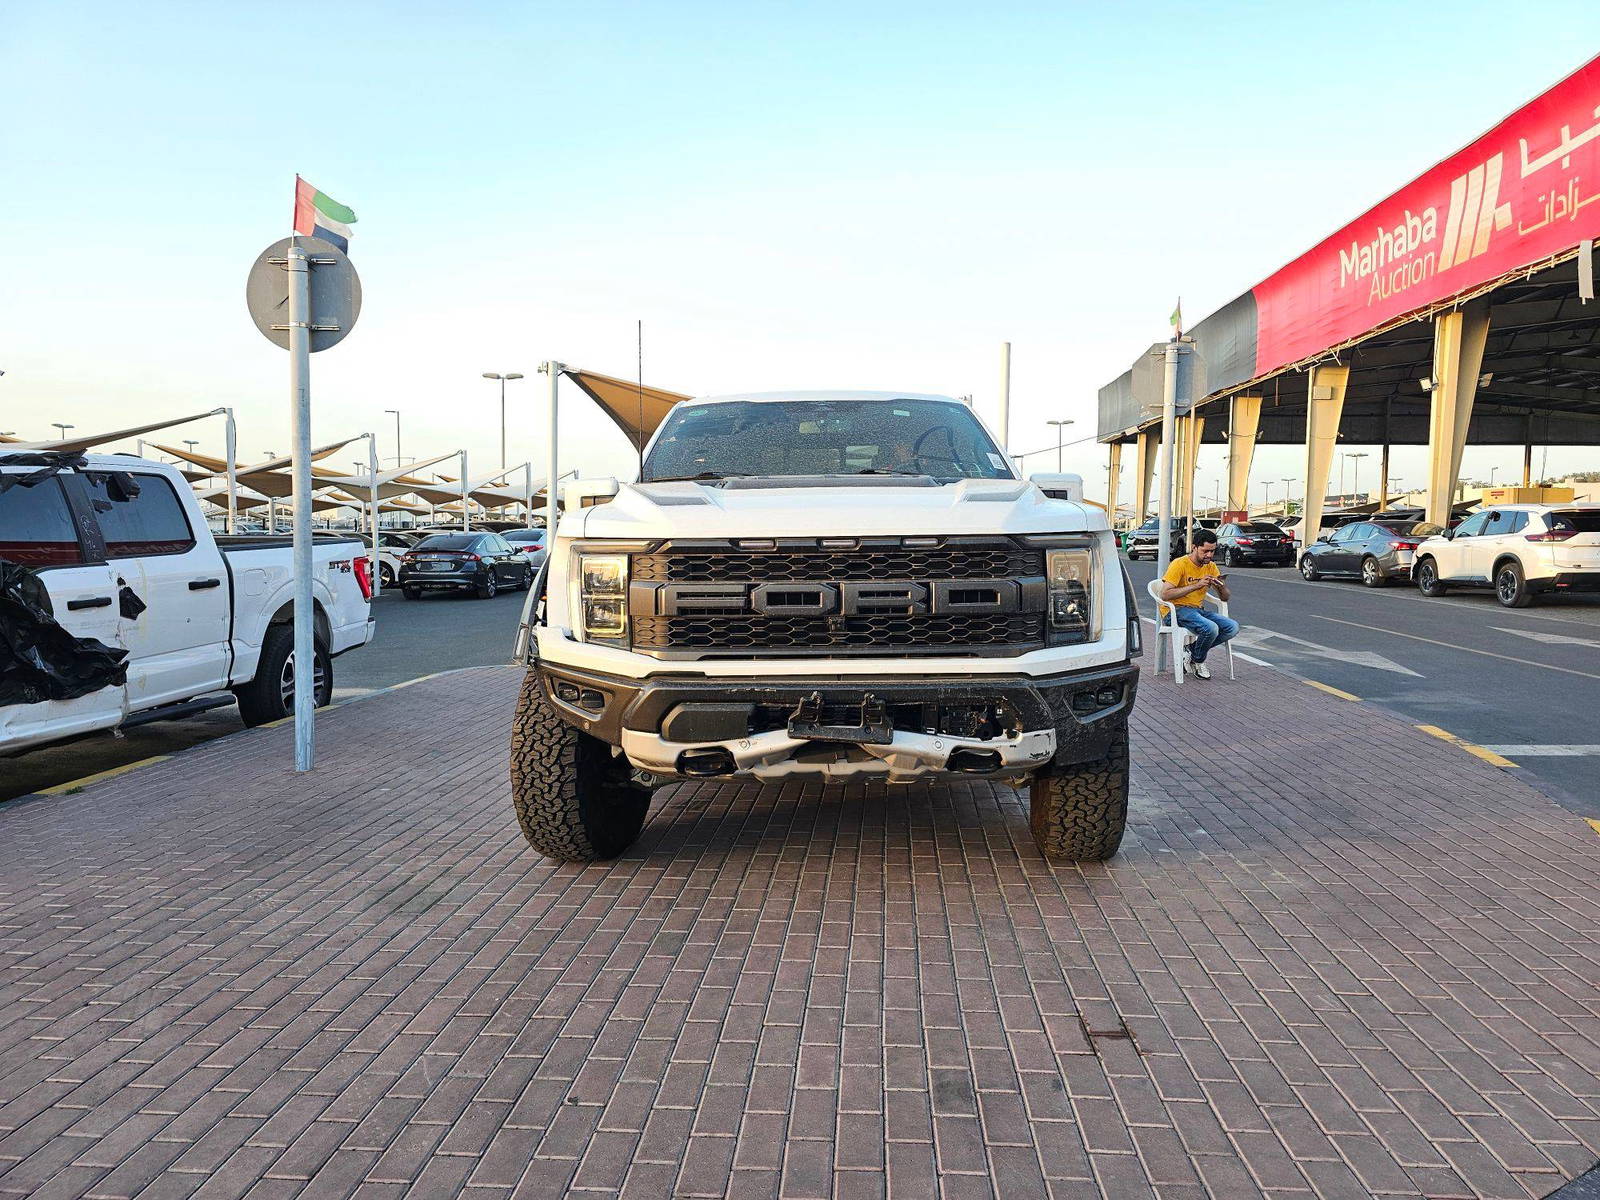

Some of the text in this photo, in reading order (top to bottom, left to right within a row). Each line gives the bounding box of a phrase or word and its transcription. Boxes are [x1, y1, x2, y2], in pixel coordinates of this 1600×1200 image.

[1518, 176, 1600, 236] زادات
[1339, 206, 1437, 288] Marhaba
[1368, 251, 1435, 306] Auction
[656, 580, 1022, 616] FORD
